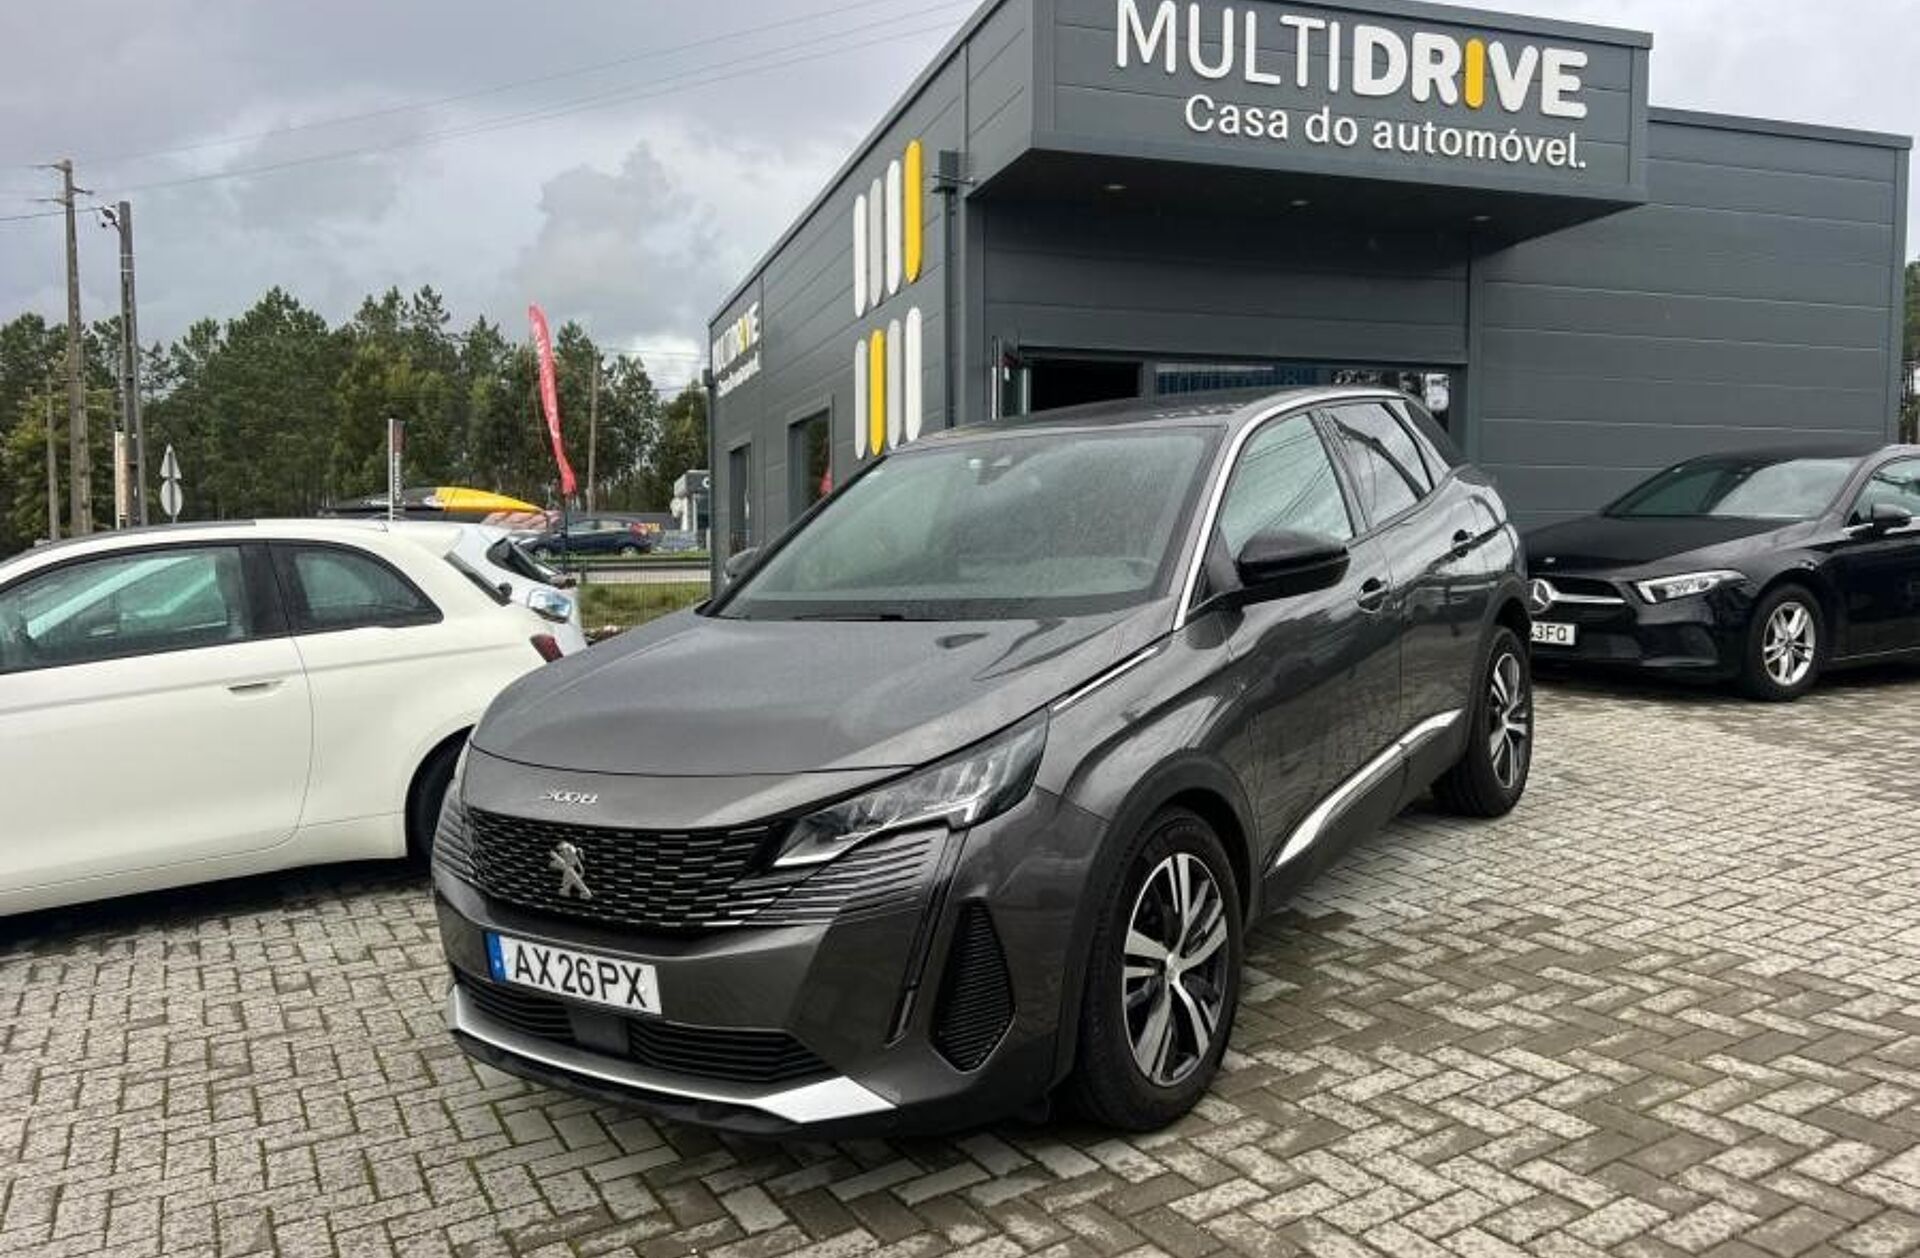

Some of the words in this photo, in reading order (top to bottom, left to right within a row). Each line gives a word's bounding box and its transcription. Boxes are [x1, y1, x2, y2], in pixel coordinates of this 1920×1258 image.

[1116, 0, 1588, 119] MULTIDRIVE
[1185, 94, 1289, 139] Casa
[1305, 105, 1358, 146] do
[1372, 120, 1586, 168] automóvel.
